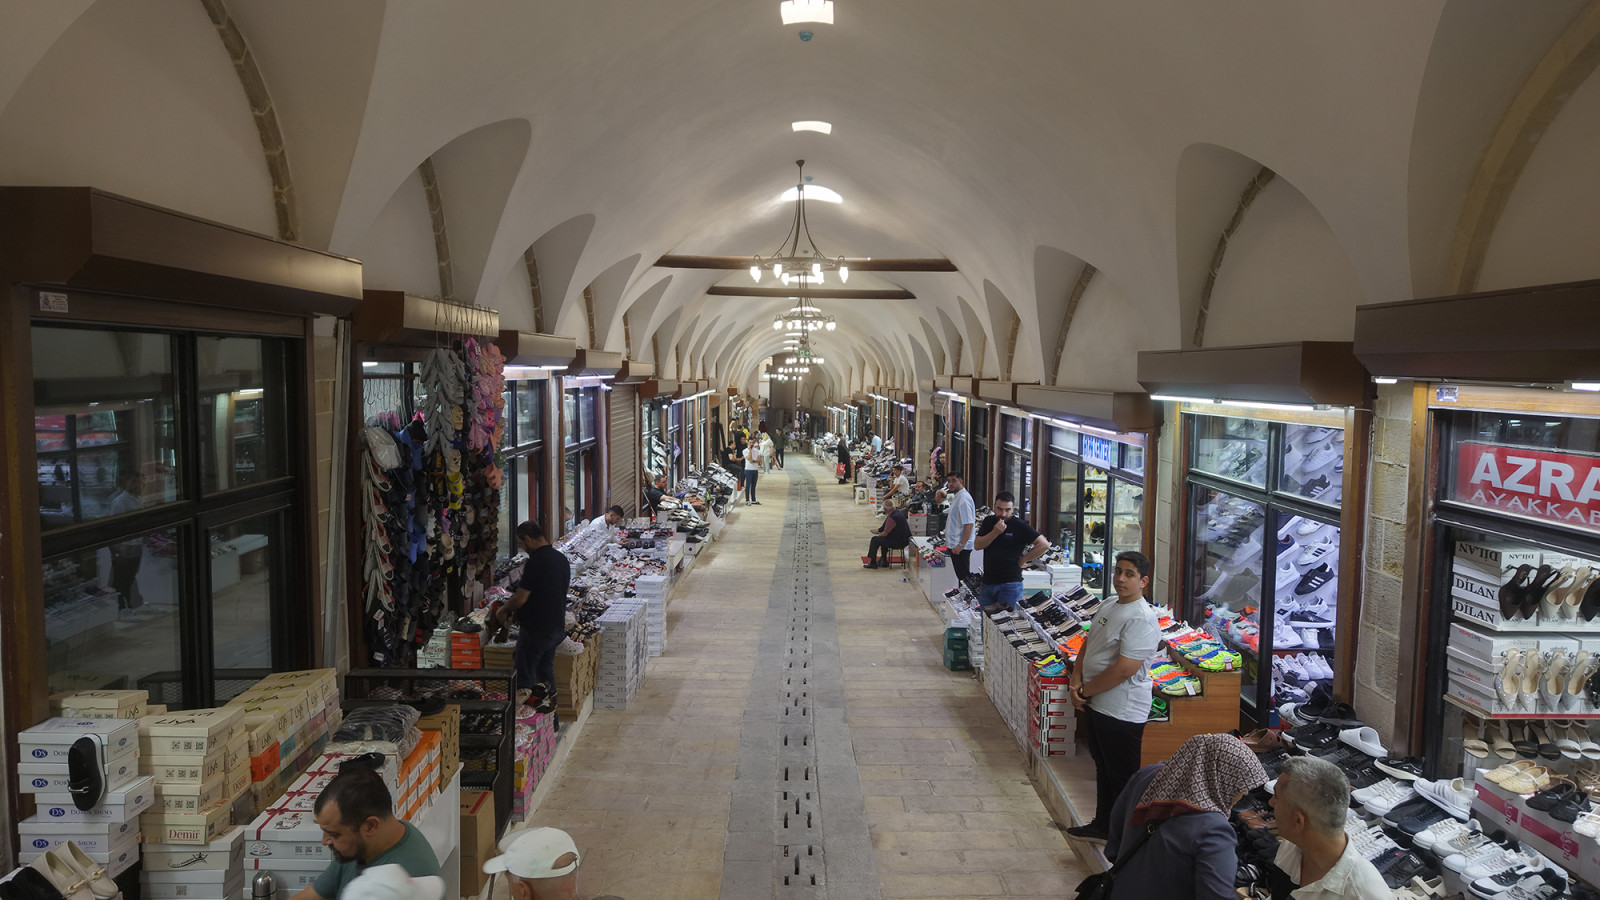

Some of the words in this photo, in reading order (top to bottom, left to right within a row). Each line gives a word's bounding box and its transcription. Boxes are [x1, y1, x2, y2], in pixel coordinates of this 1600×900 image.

[1470, 452, 1600, 504] AZRA
[1470, 489, 1600, 526] AYAKKAB
[1458, 542, 1499, 562] DİLAN
[1455, 577, 1495, 600] DİLAN
[1454, 601, 1495, 624] DİLAN
[168, 829, 200, 839] Demir
